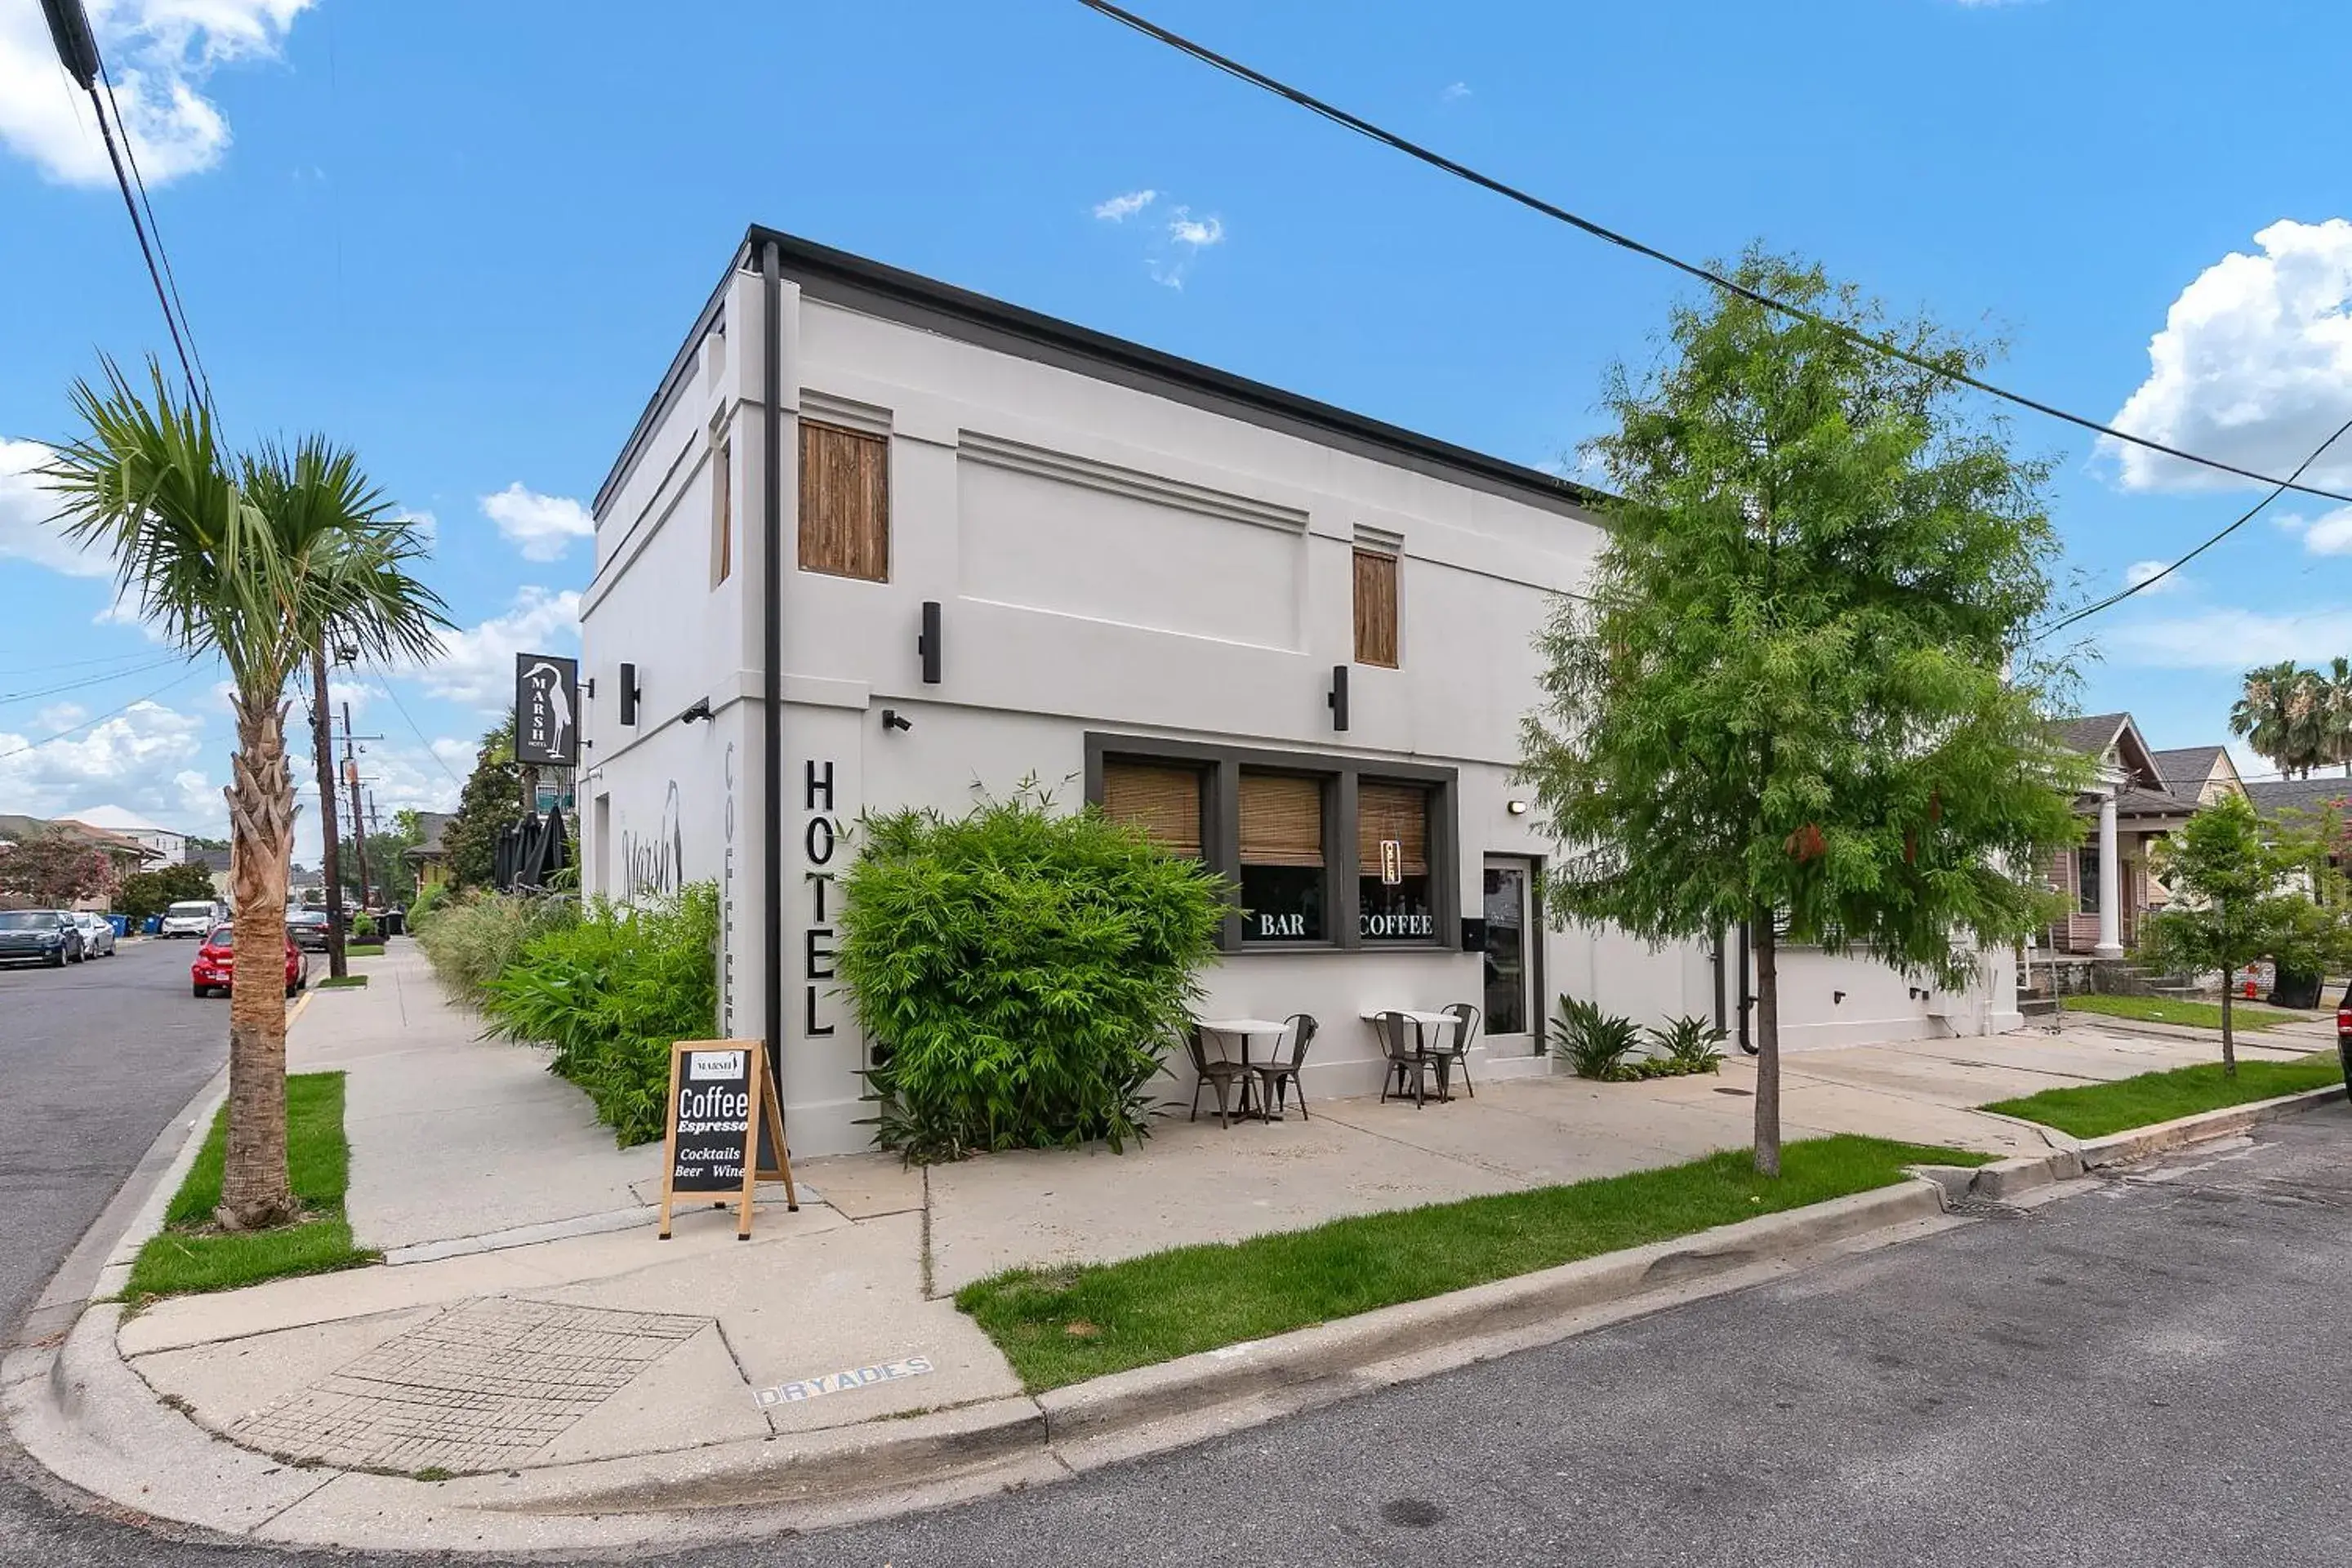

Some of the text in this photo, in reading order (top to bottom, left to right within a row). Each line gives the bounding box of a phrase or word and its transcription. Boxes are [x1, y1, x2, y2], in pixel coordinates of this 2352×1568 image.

[532, 677, 546, 741] MARSH
[724, 742, 734, 1039] COFFEE
[804, 760, 835, 1038] HOTEL
[1260, 913, 1306, 937] BAR
[1358, 914, 1433, 937] COFFEE
[680, 1086, 749, 1119] Coffee
[677, 1120, 749, 1134] Espresso
[679, 1147, 741, 1160] Cocktails
[675, 1165, 746, 1178] Beer Wine
[755, 1356, 933, 1406] DRYADES
